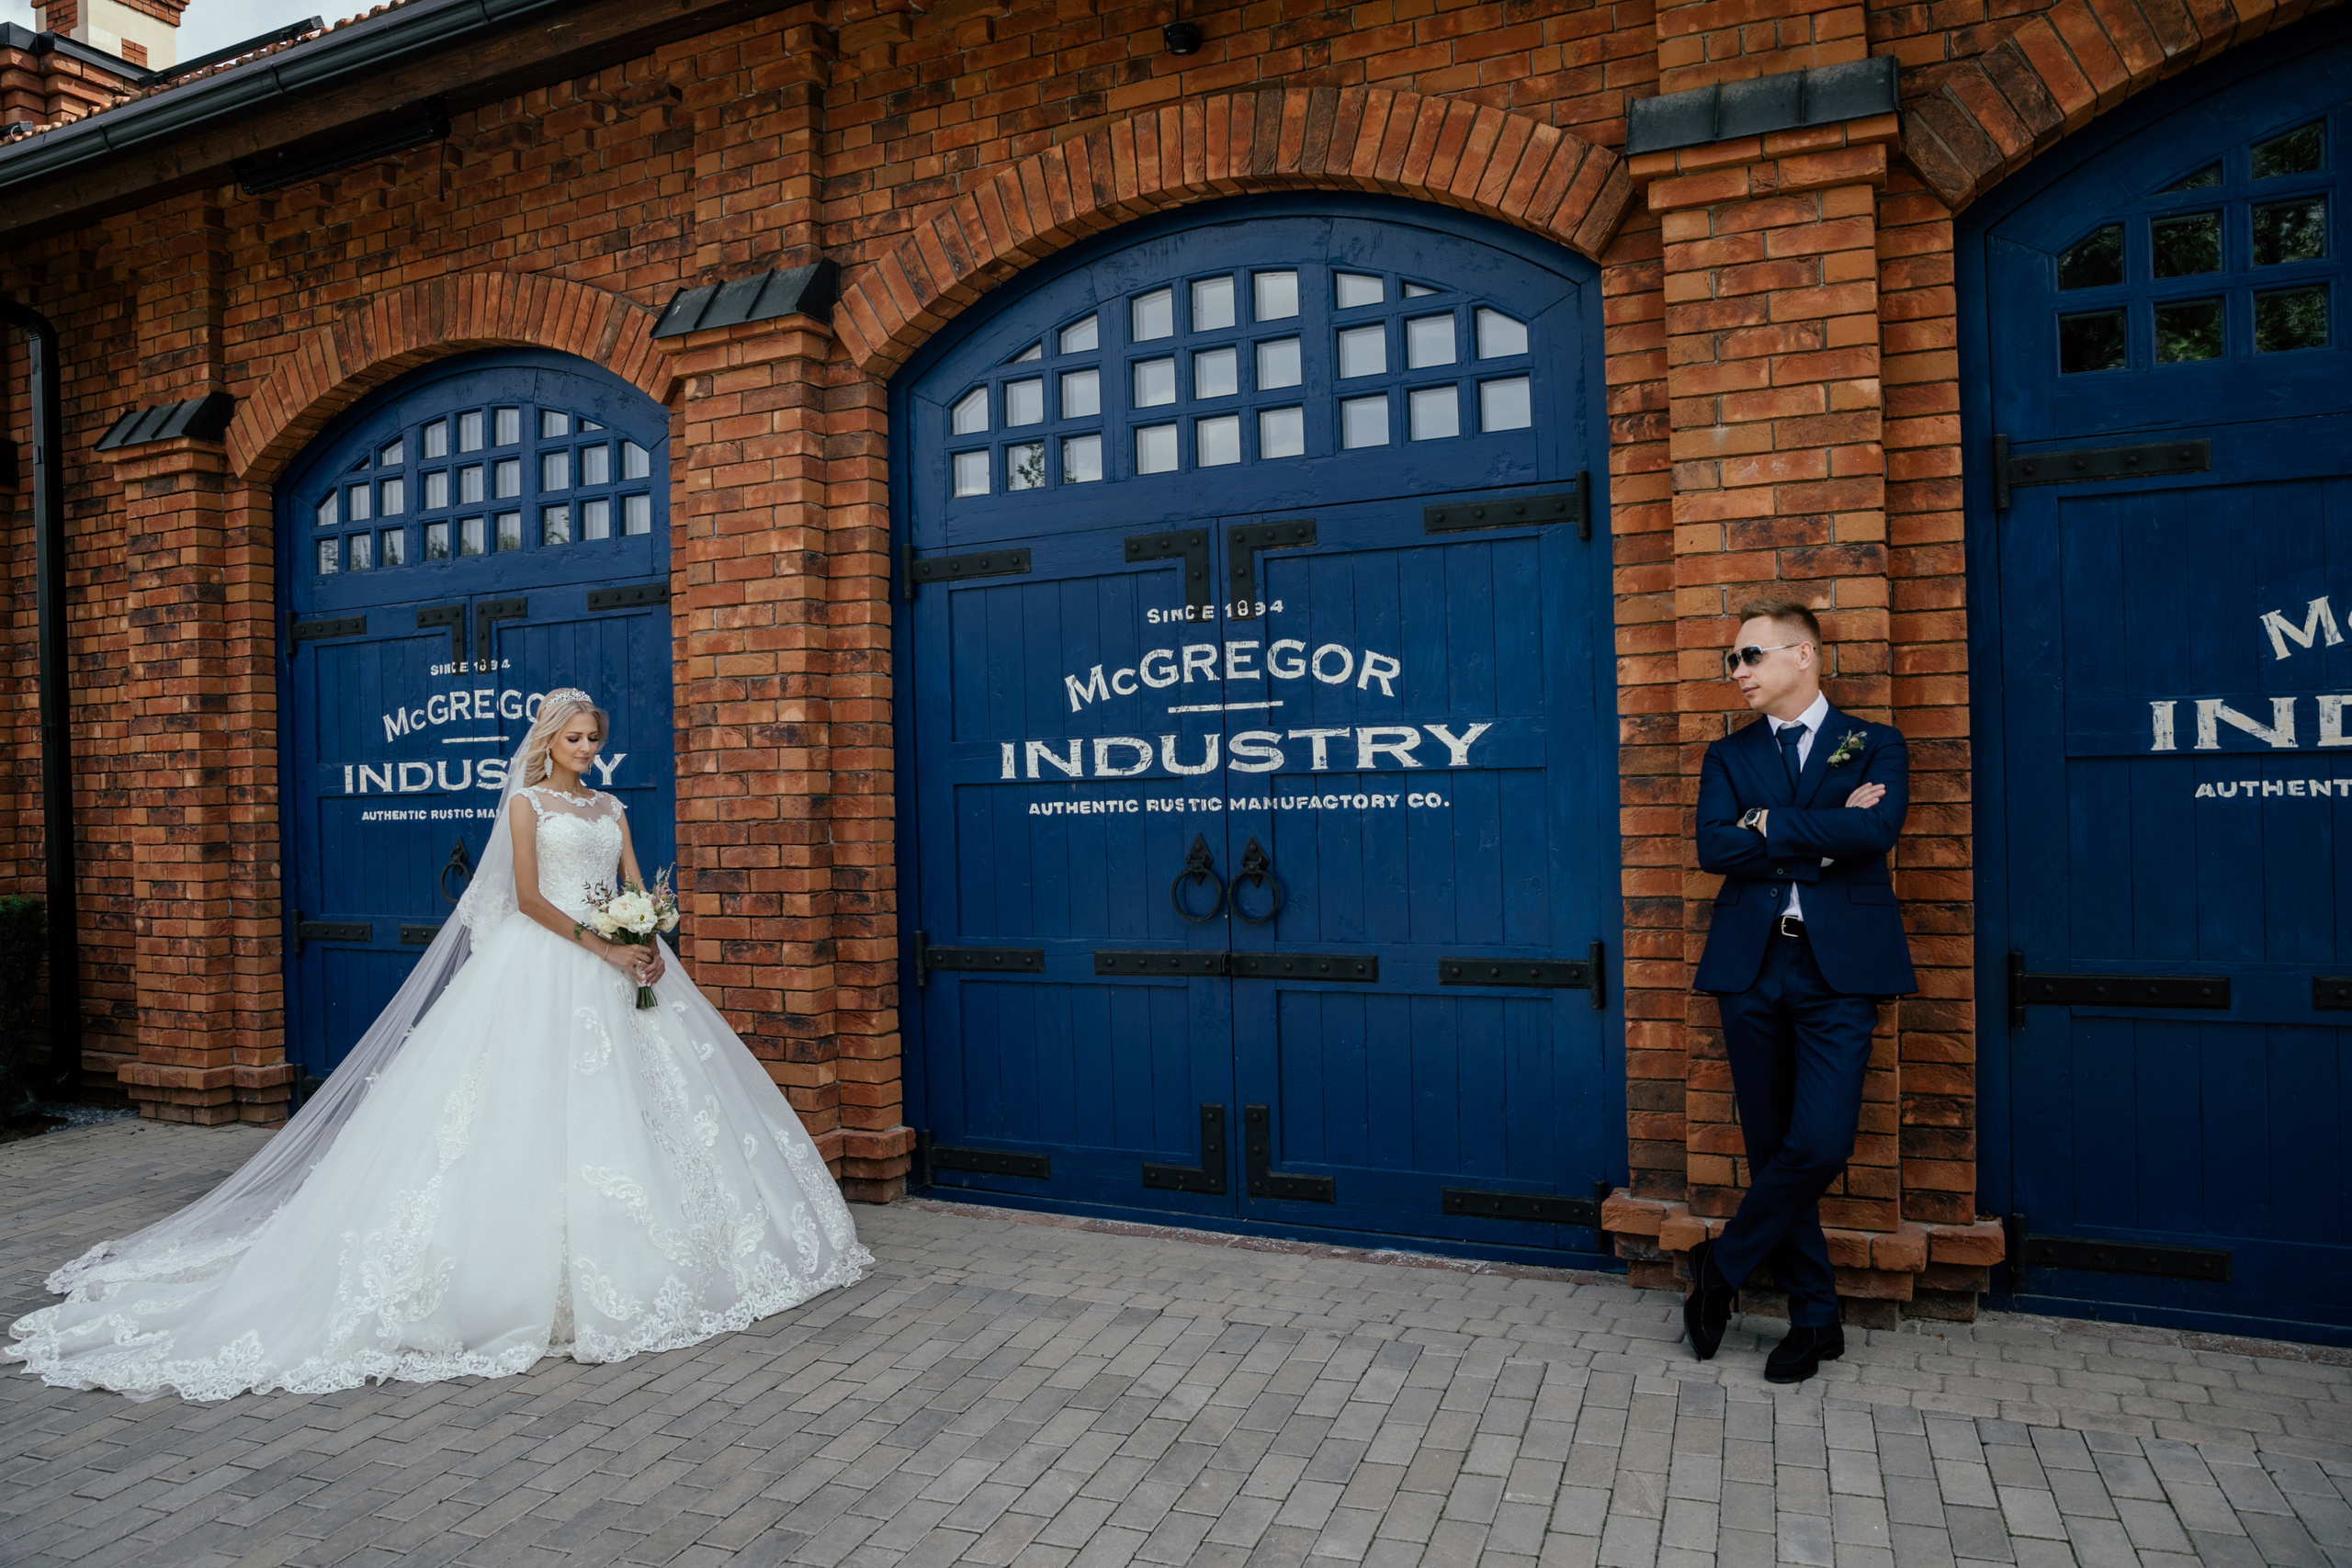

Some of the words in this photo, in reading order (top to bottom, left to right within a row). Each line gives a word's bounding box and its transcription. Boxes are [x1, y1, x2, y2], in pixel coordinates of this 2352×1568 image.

[1147, 604, 1216, 624] SINCE
[1224, 599, 1284, 618] 1894
[430, 661, 469, 676] SINCE
[1064, 638, 1402, 713] McGREGOR
[382, 689, 547, 743] McGREGO
[1000, 722, 1494, 779] INDUSTRY
[344, 753, 628, 794] INDUSY
[361, 809, 427, 822] AUTHENTIC
[430, 807, 474, 820] RUSTIC
[1028, 799, 1139, 817] AUTHENTIC
[1146, 796, 1223, 813] RUSTIC
[1229, 793, 1400, 811] MANUFACTORY
[1407, 792, 1450, 808] CO.
